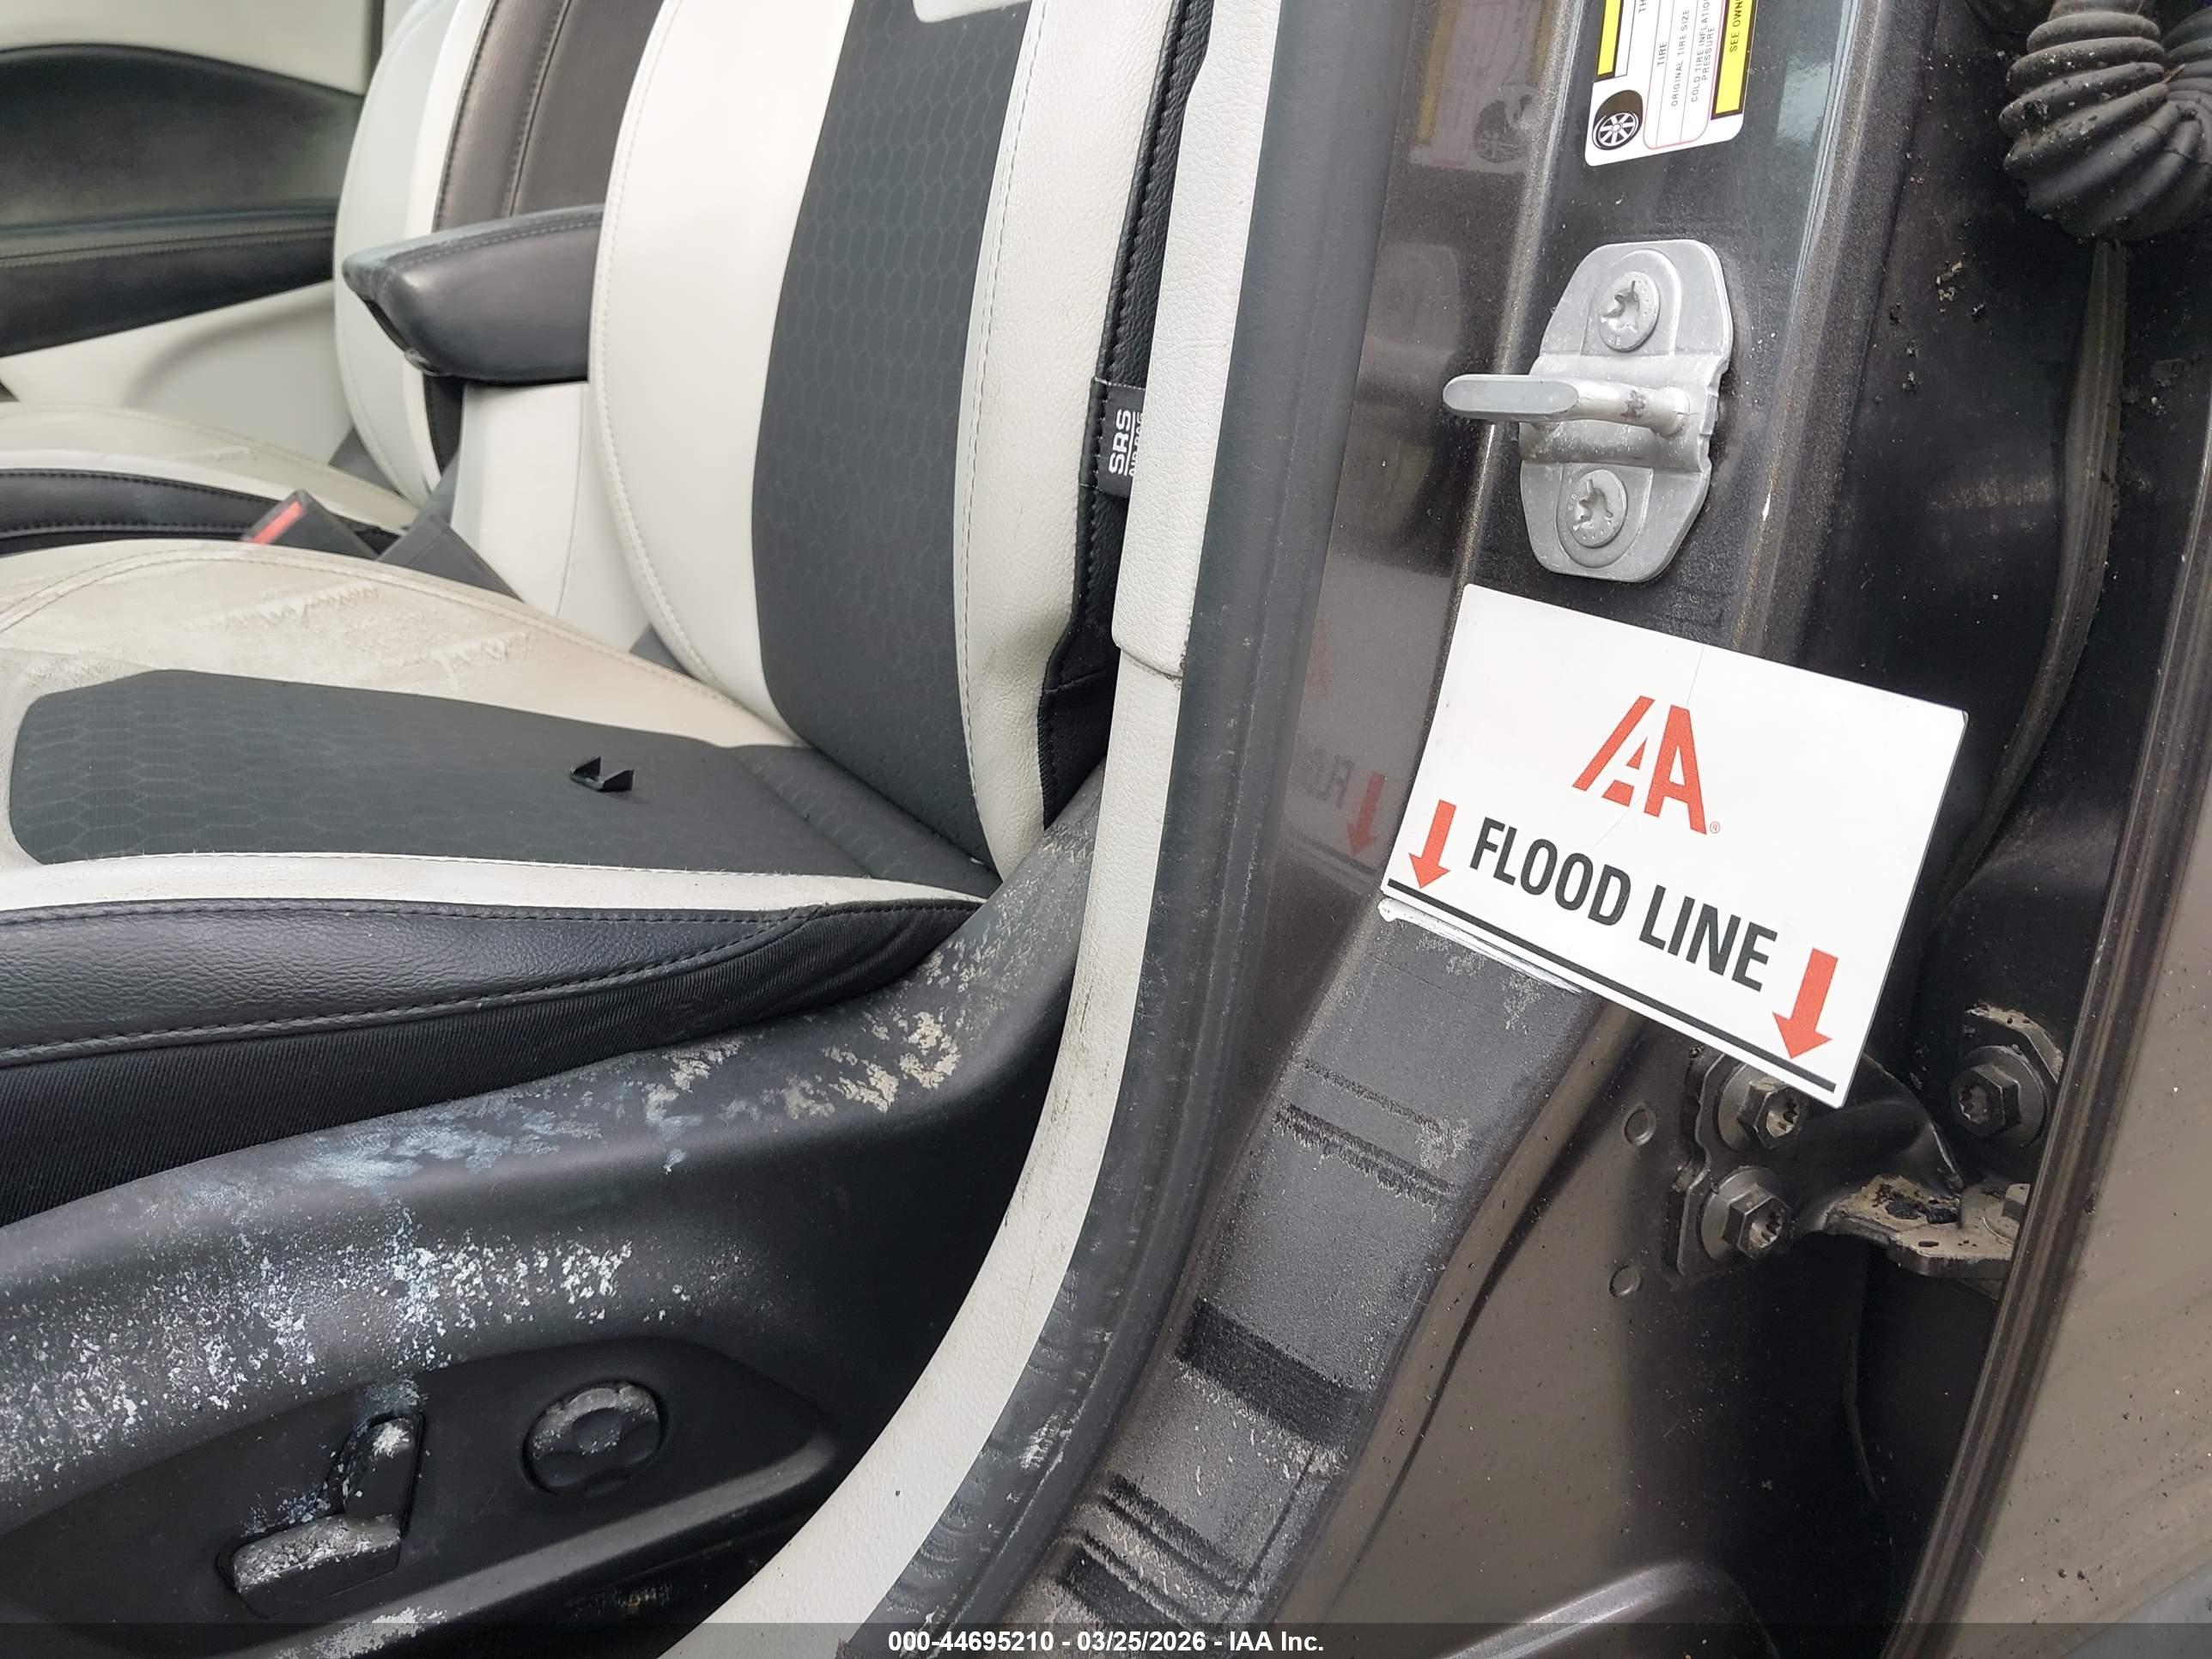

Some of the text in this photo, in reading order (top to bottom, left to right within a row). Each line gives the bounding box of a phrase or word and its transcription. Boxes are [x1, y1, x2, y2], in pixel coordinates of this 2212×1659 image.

[1656, 42, 1668, 67] TIRE
[1671, 9, 1690, 106] ORIGINAL TIRE SIZE
[1691, 0, 1711, 102] COLD TIRE INFLATIO
[1701, 27, 1715, 81] PRESSURE
[1729, 0, 1744, 52] SEE OWN
[1108, 409, 1132, 475] SRS
[1469, 817, 1778, 992] FLOOD LINE
